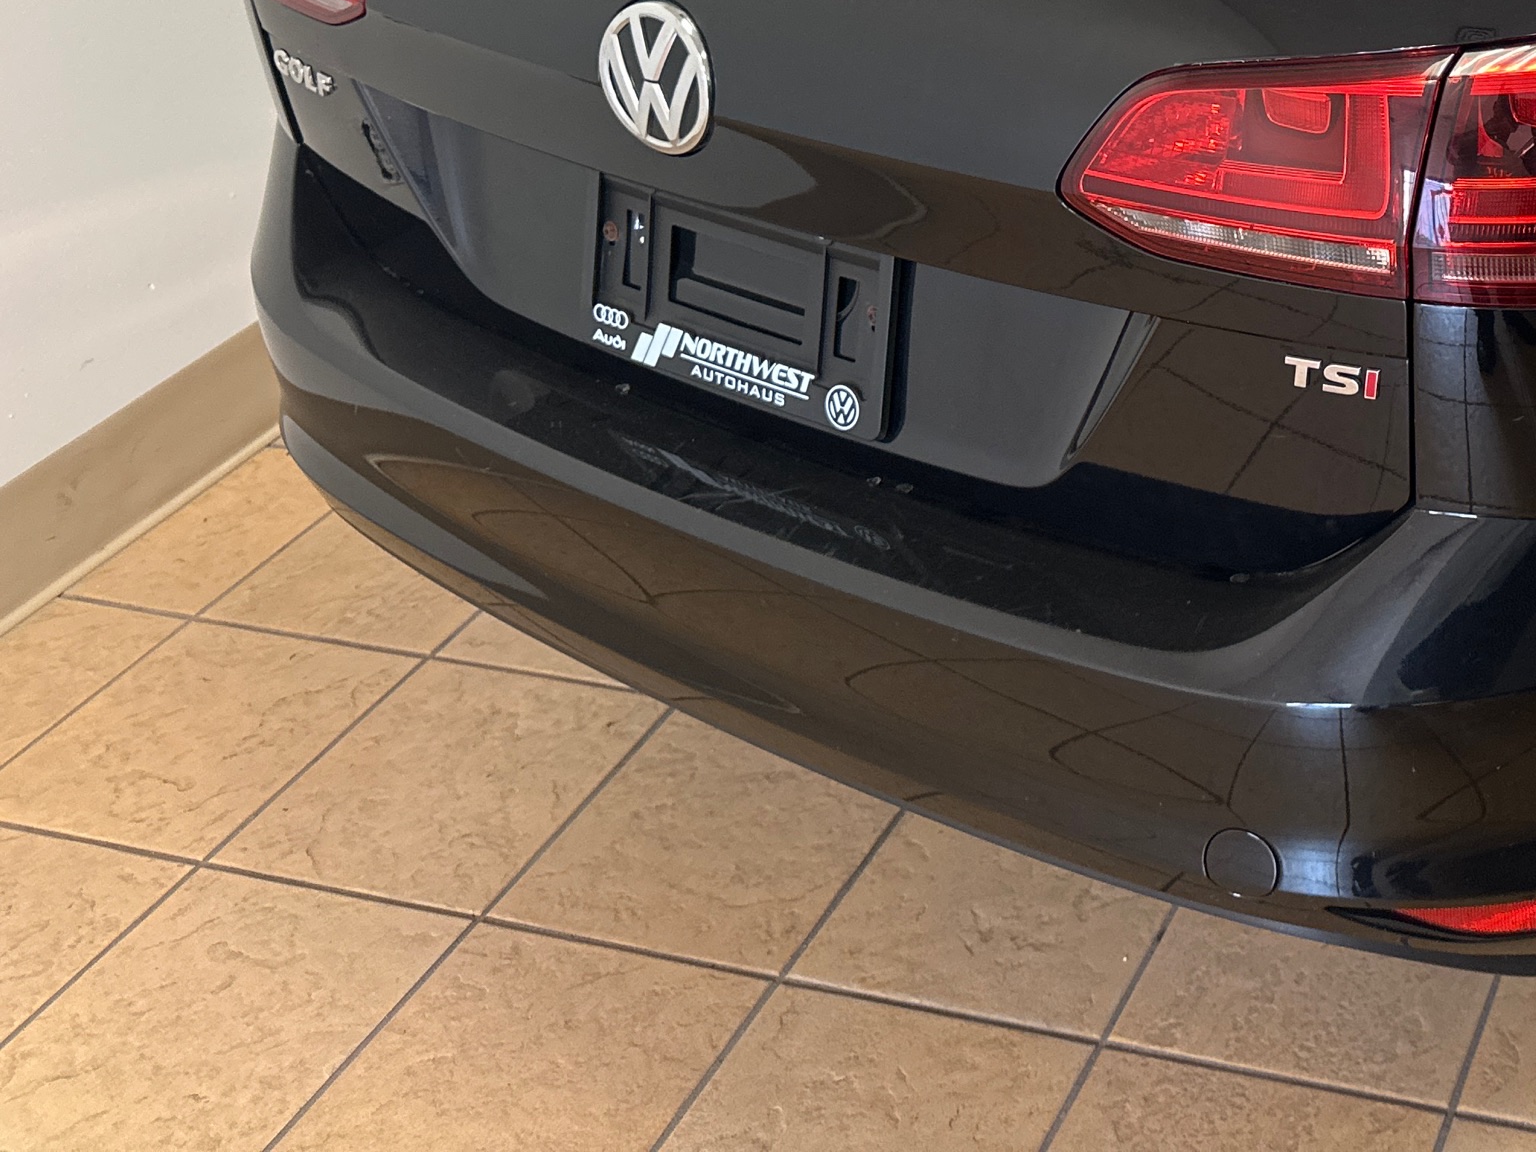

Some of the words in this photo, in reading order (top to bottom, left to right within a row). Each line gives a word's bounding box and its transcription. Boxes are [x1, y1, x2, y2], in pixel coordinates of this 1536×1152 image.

[273, 49, 335, 97] GOLF
[592, 329, 626, 351] Audi
[680, 332, 815, 393] NORTHWEST
[690, 365, 785, 407] AUTOHAUS
